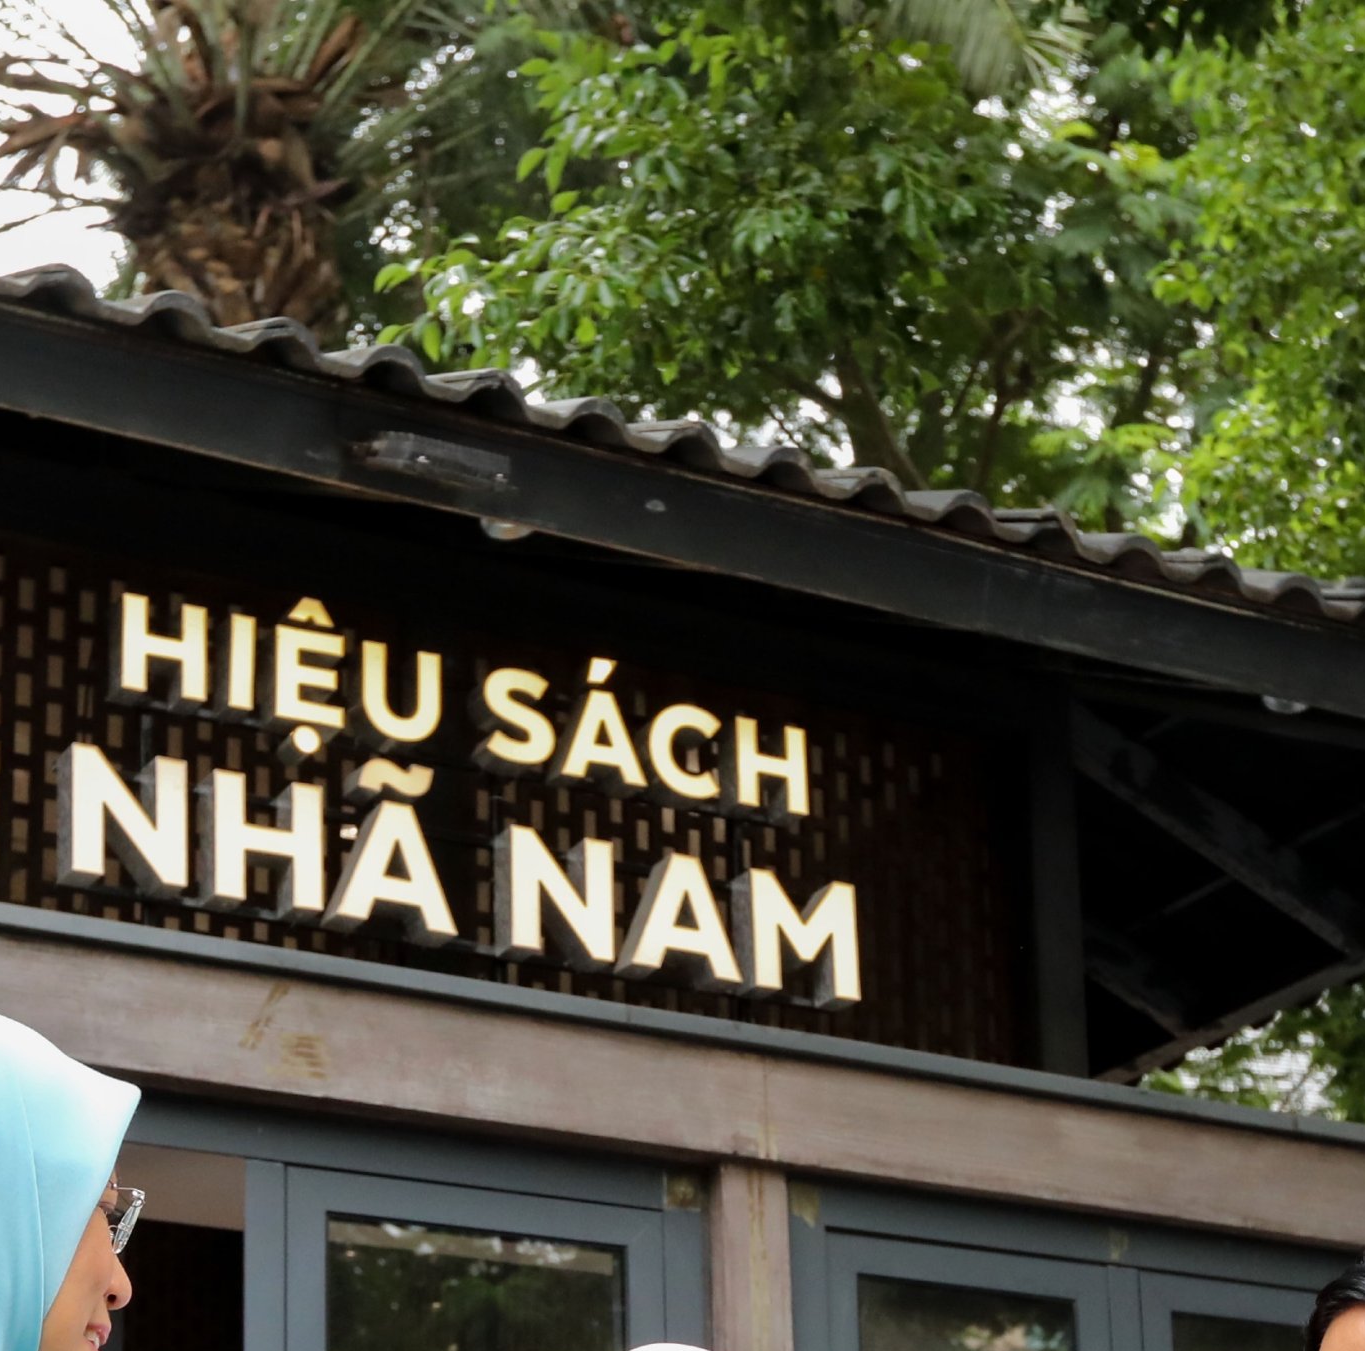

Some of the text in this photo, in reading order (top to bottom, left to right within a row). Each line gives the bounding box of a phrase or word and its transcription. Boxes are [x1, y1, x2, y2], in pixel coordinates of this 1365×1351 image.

[120, 592, 811, 818] HIỆU SÁCH
[70, 743, 861, 1003] NHÃ NAM
